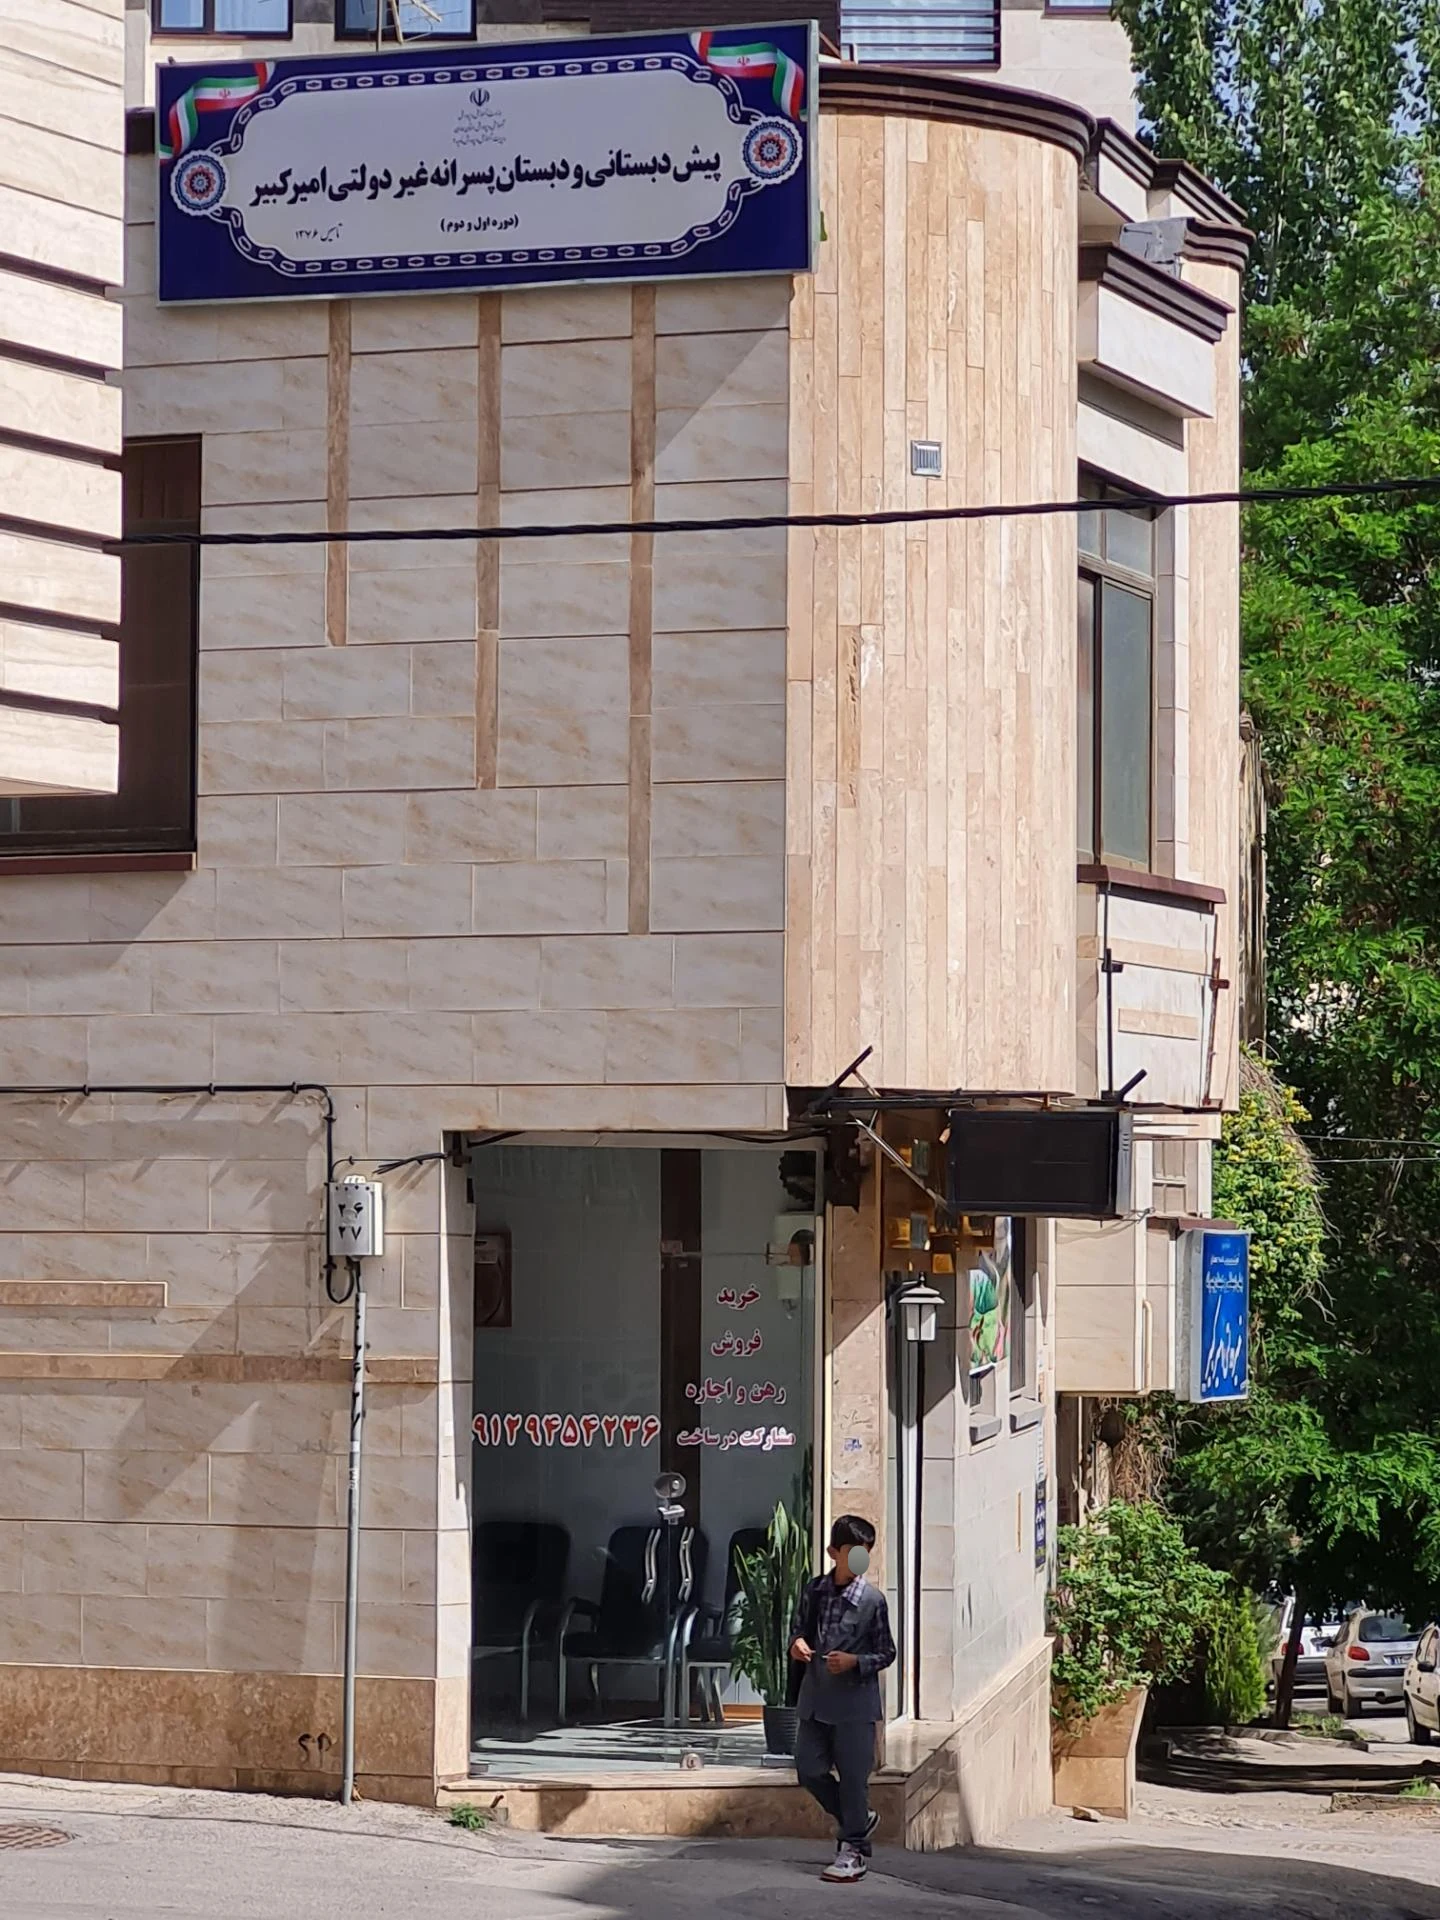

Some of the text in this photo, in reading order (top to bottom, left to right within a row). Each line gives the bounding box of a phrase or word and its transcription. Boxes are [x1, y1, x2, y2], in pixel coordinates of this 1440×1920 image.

[430, 158, 495, 196] پسرانه
[496, 154, 570, 193] دبستان
[570, 163, 584, 189] و
[584, 149, 672, 188] دبستانی
[673, 144, 721, 183] پیش
[473, 216, 490, 231] اول
[717, 1283, 761, 1311] خرید
[711, 1328, 763, 1357] فروش
[685, 1377, 787, 1405] رهن و اجاره
[472, 1413, 661, 1447] ۹۱۲۹۴۵۴۲۳۶
[676, 1426, 797, 1451] مشارکت در ساخت
